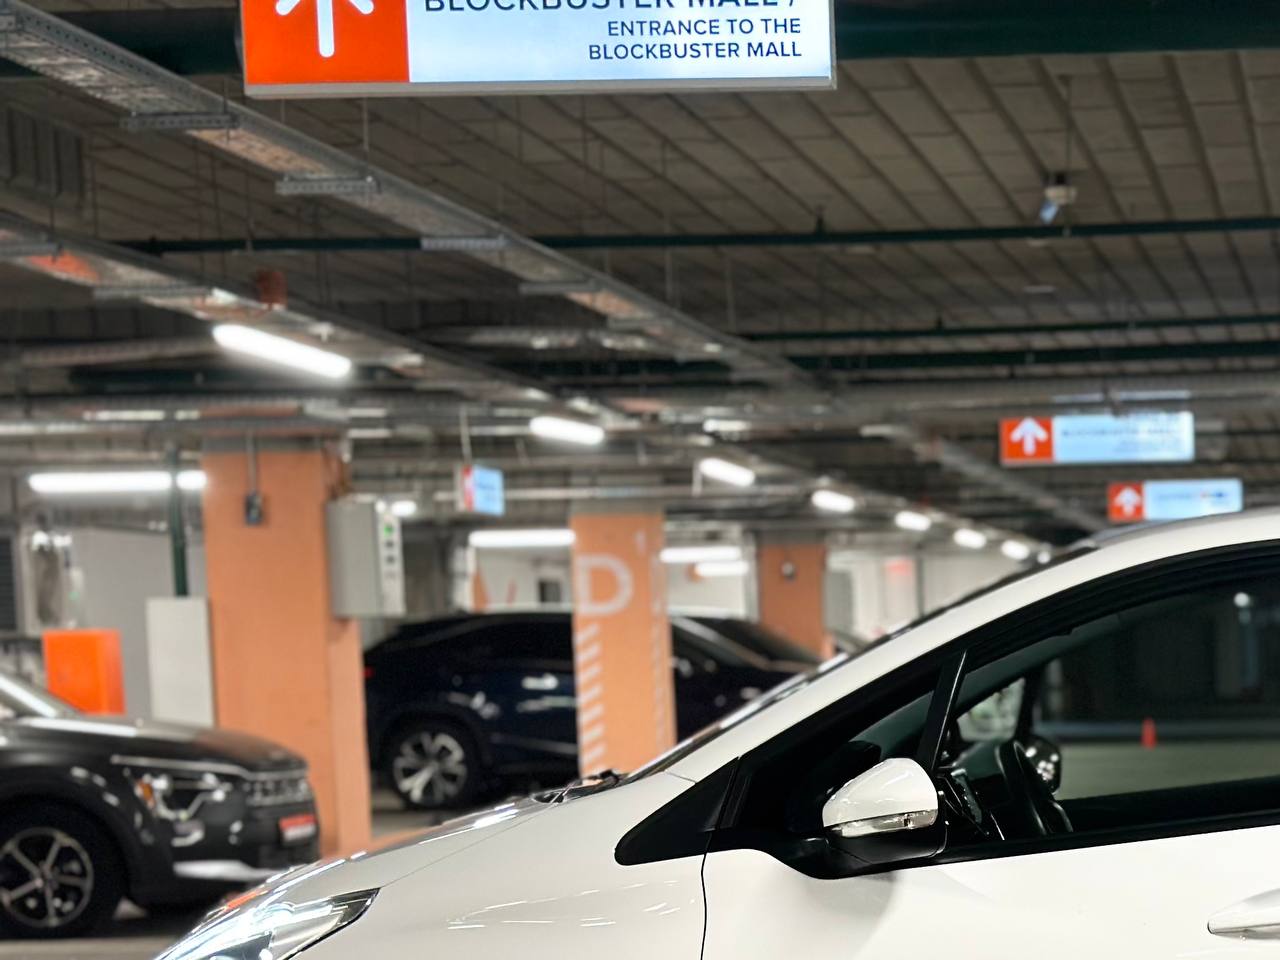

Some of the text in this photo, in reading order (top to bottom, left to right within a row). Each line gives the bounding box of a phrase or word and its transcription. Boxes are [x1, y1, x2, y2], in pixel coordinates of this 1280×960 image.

[607, 18, 801, 36] ENTRANCE TO THE
[588, 41, 802, 60] BLOCKBUSTER MALL
